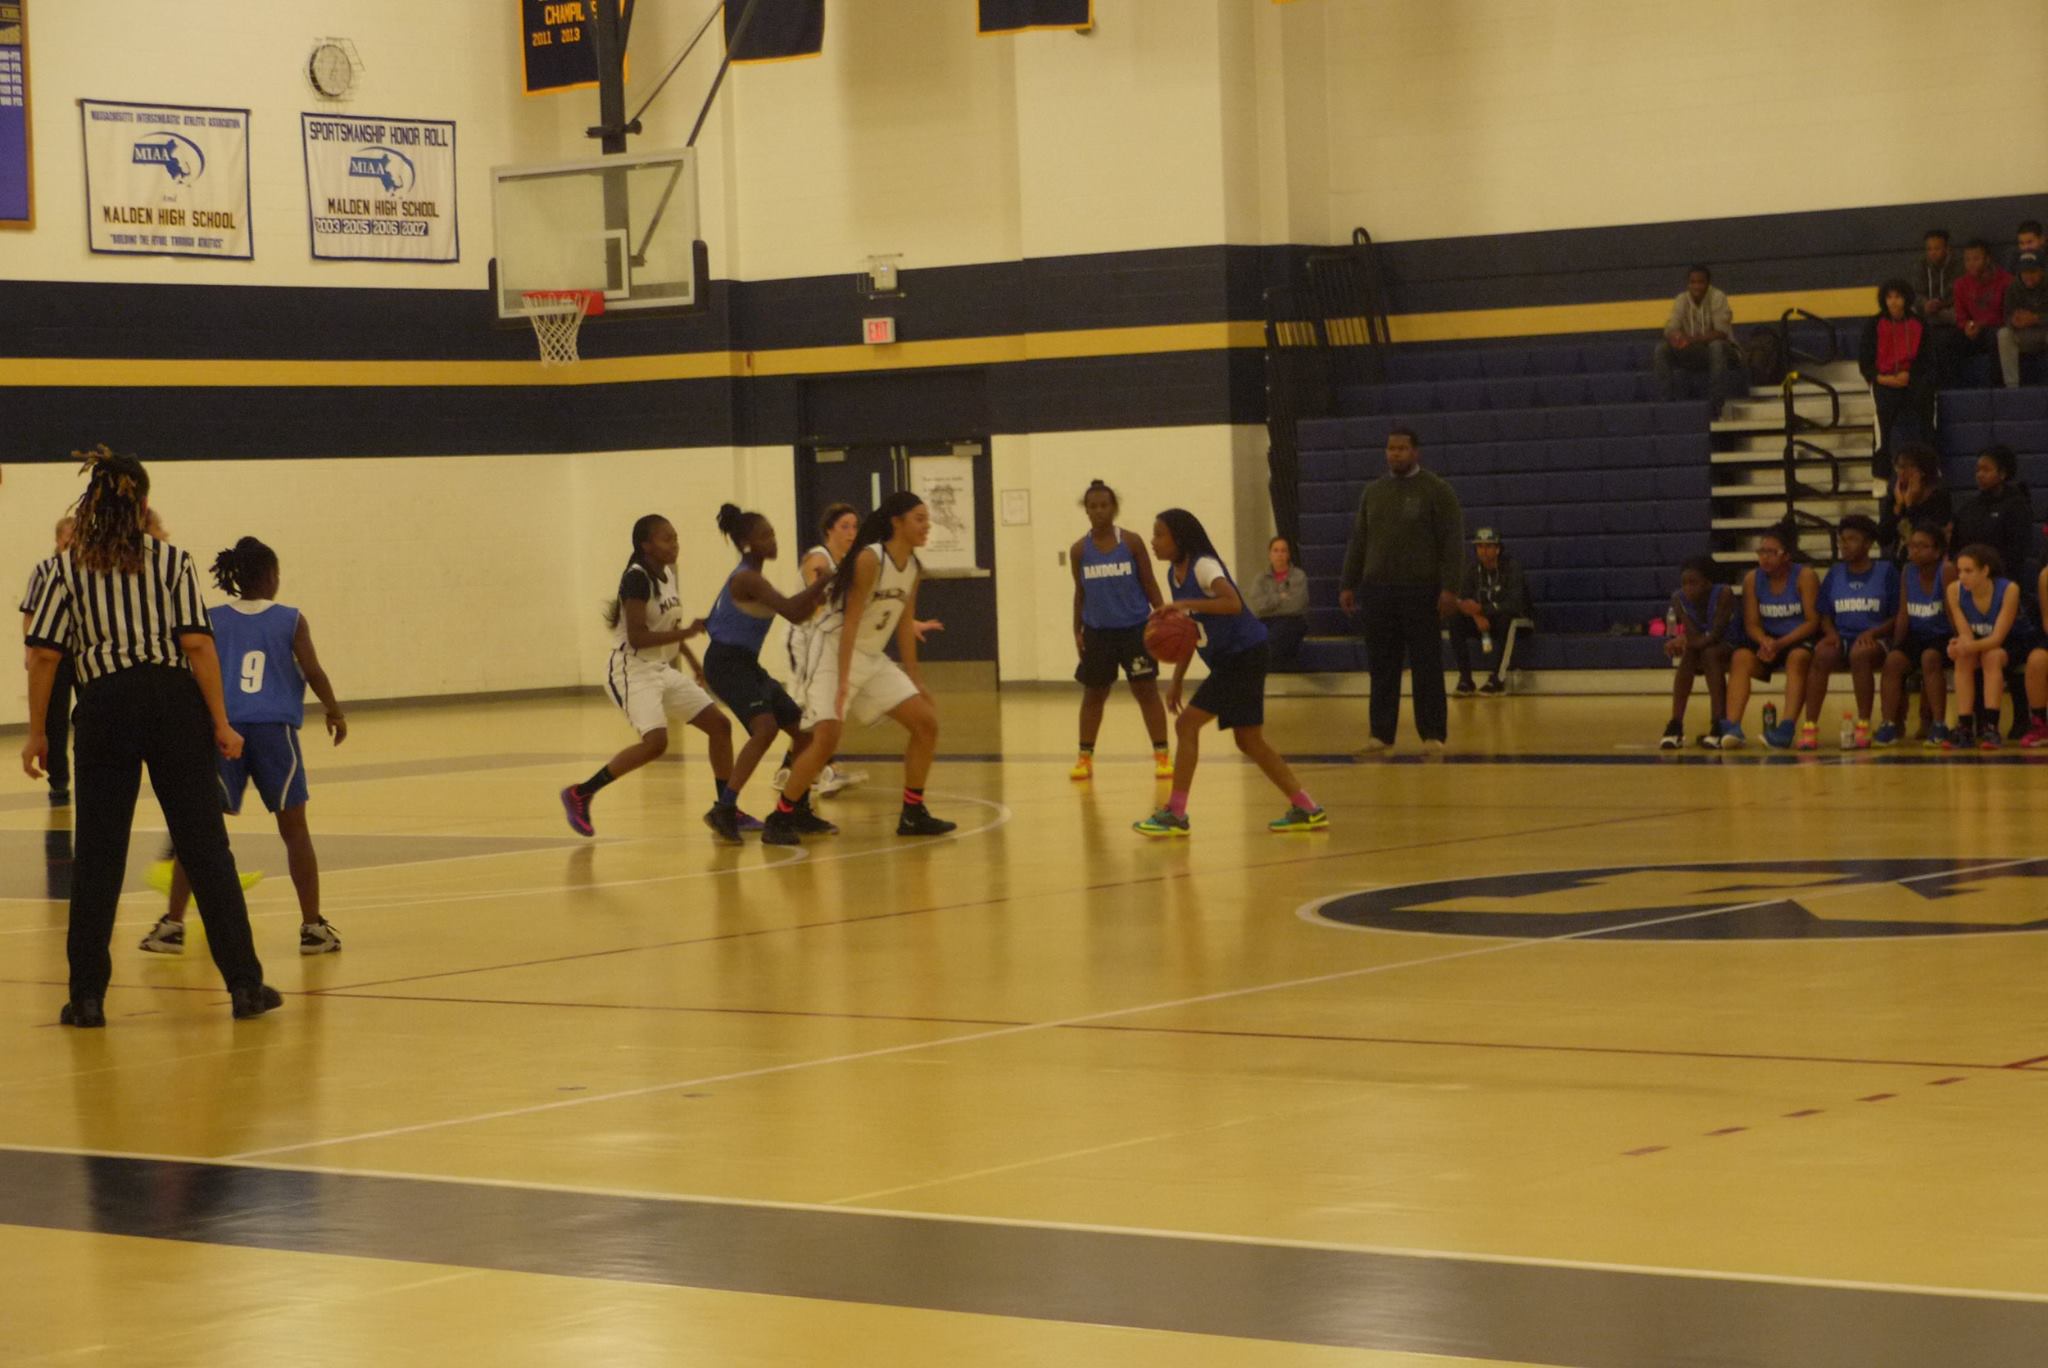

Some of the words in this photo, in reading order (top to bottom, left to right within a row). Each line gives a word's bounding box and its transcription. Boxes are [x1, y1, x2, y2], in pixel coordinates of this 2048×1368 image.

[532, 31, 552, 47] 2011
[561, 27, 580, 44] 2013
[310, 121, 386, 144] SPORTSMANSHIP
[390, 126, 420, 146] HONOR
[424, 128, 449, 147] ROLL
[134, 147, 170, 161] MIAA
[351, 160, 385, 175] MIAA
[103, 205, 153, 225] MALDEN
[158, 208, 185, 226] HIGH
[192, 210, 236, 229] SCHOOL
[328, 198, 370, 215] MALDEN
[375, 200, 398, 216] HIGH
[402, 201, 440, 218] SCHOOL
[868, 320, 889, 341] EXIT
[1083, 561, 1132, 579] RANDOLPH
[1834, 597, 1880, 613] RANDOLPH
[240, 650, 265, 694] 9
